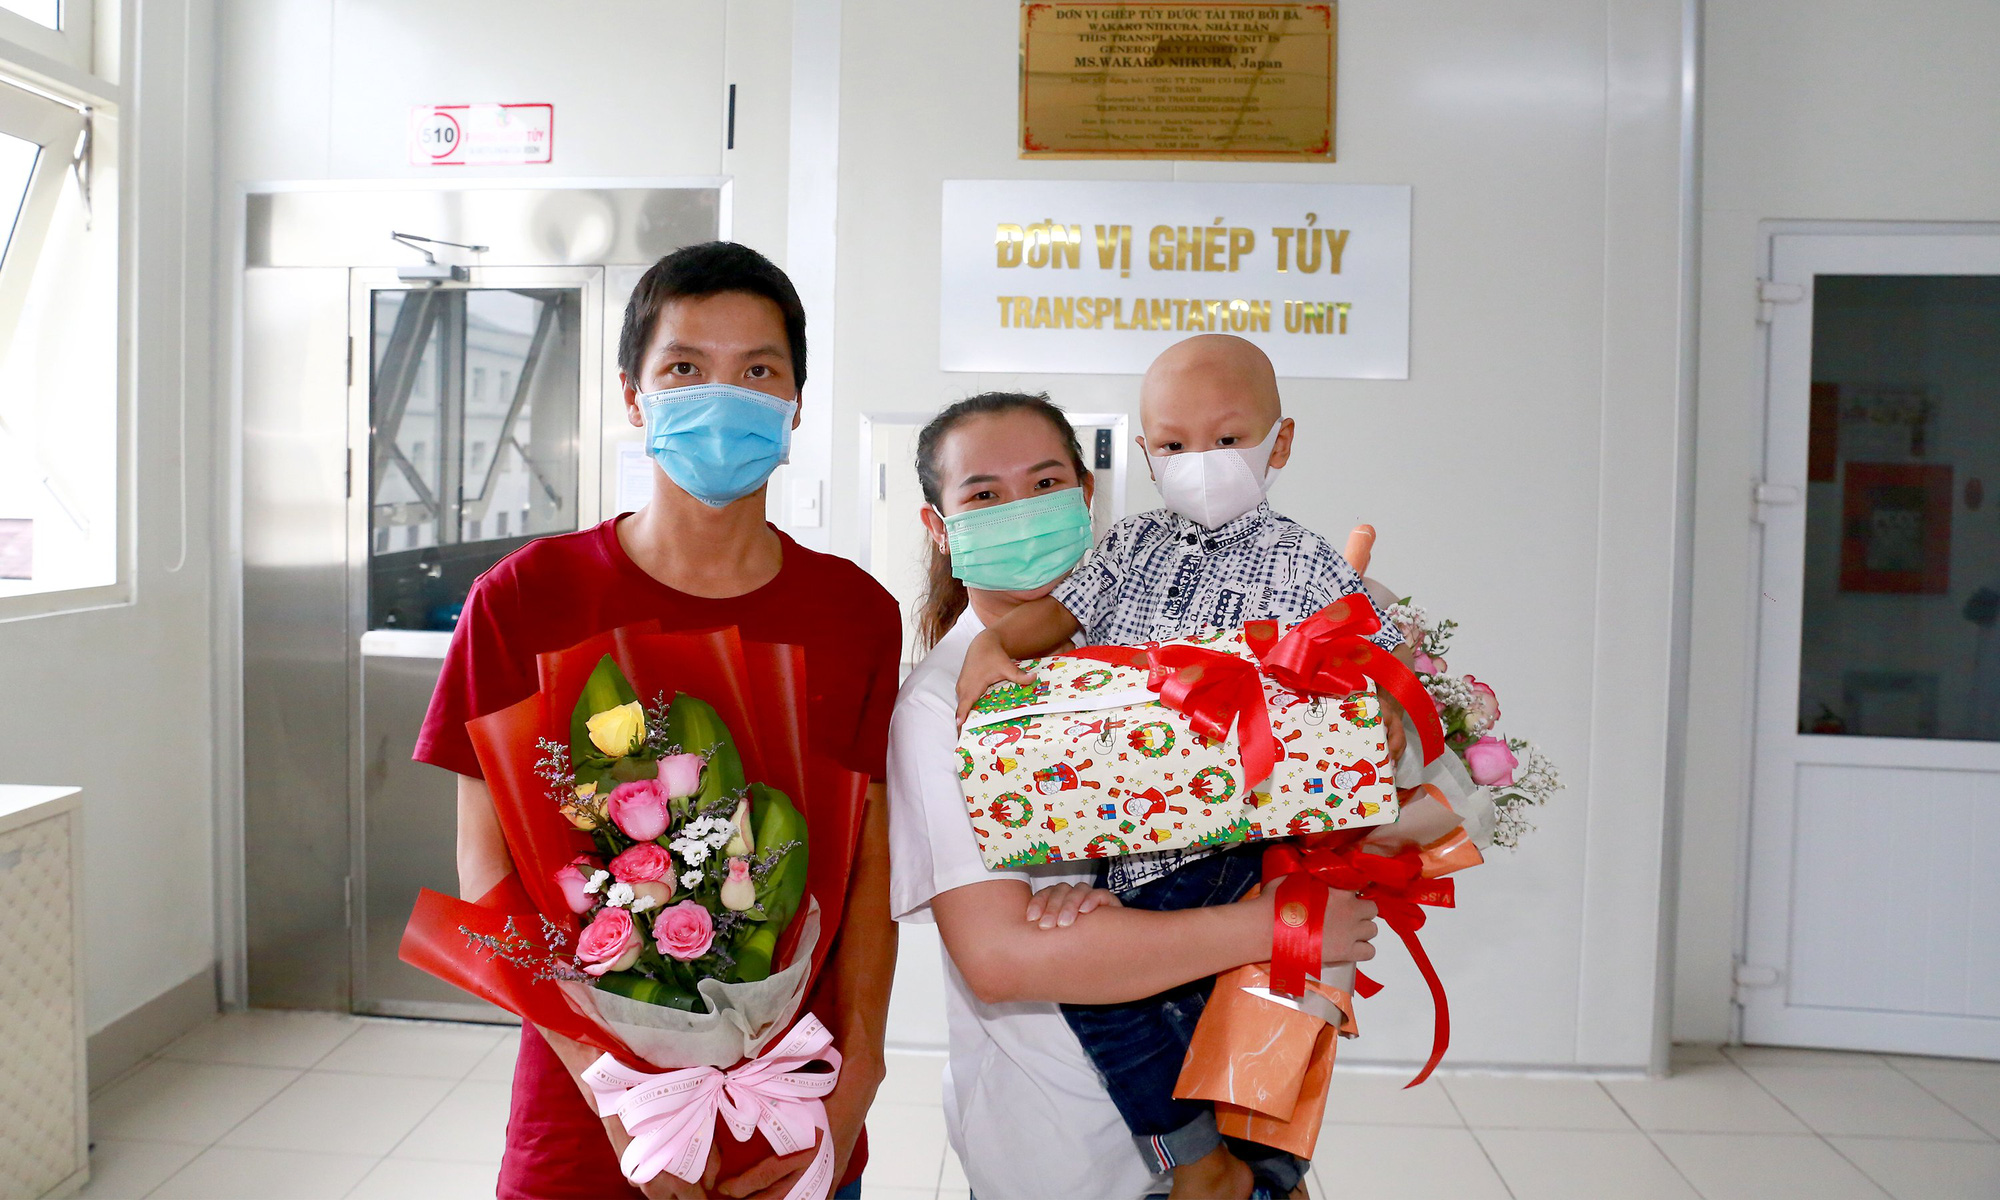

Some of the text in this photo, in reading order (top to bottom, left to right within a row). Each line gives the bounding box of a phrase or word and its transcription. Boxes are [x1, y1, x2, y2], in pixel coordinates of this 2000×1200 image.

[1089, 23, 1142, 31] WAKAKO
[1078, 34, 1280, 43] THIS TRANSPLANTATION UNIT IS
[1100, 45, 1257, 54] GENEROUSLY FUNDED BY
[1240, 57, 1283, 70] Japan
[422, 127, 454, 143] 510
[994, 213, 1350, 278] ĐƠN VỊ GHÉP TỦY
[997, 296, 1352, 335] TRANSPLANTATION UNIT
